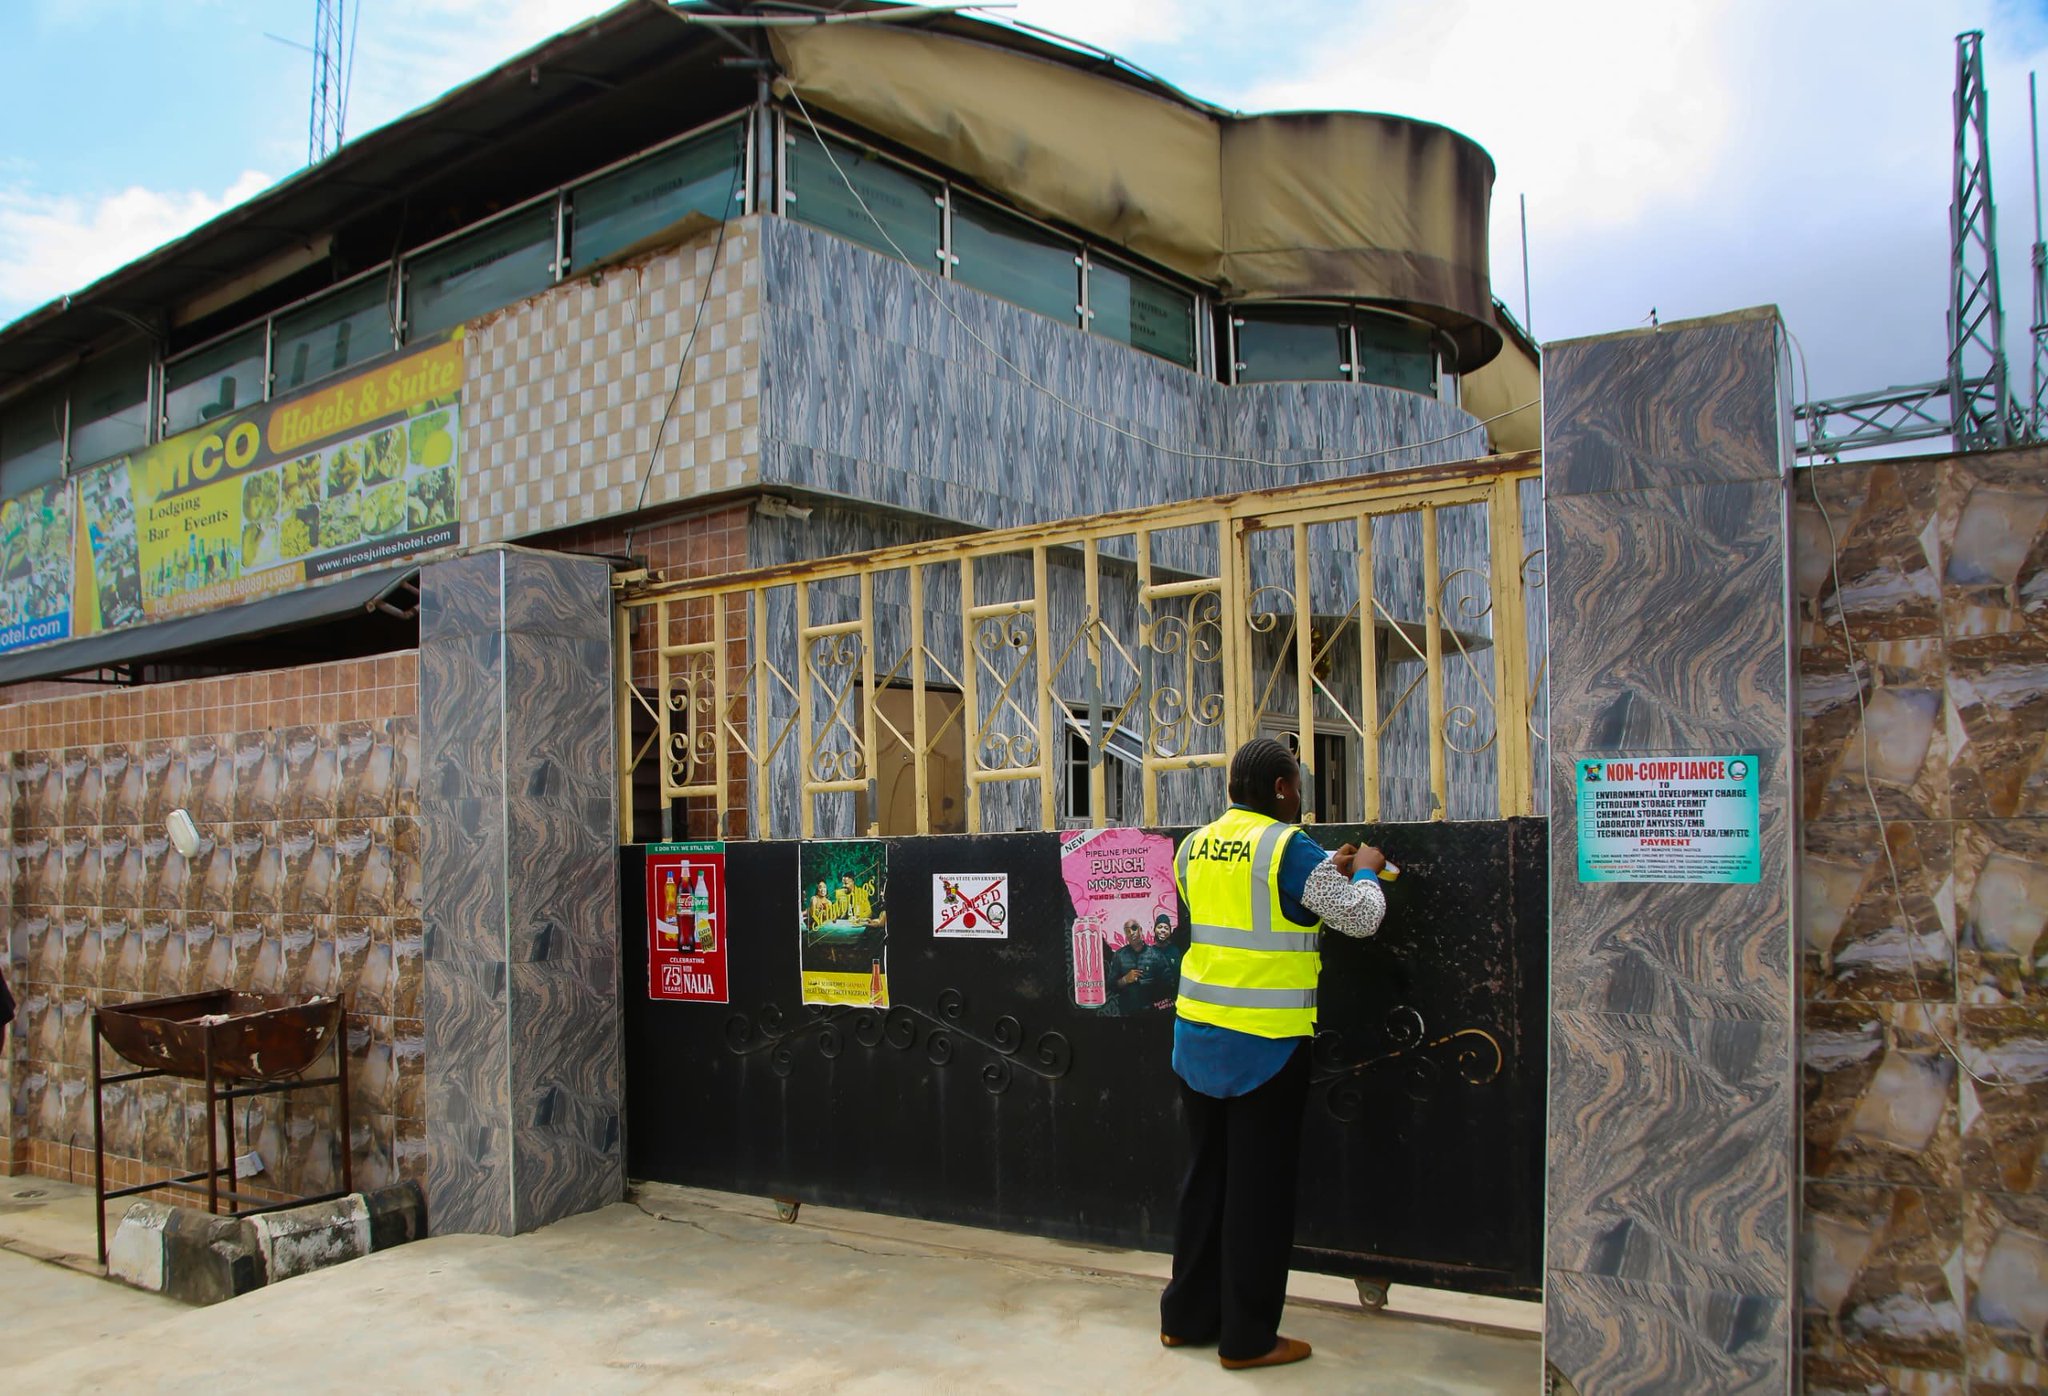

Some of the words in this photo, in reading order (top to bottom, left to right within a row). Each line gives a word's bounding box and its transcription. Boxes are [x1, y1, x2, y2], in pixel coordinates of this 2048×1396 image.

[280, 389, 354, 447] Hotels
[360, 381, 379, 417] &
[386, 359, 455, 408] Suite
[149, 497, 201, 521] Lodging
[148, 528, 170, 543] Bar
[184, 509, 229, 531] Events
[316, 530, 451, 572] www.nicosjuiteshotel.com
[1606, 761, 1725, 782] NON-COMPLIANCE
[1596, 790, 1657, 799] ENVIRONMENTAL
[1658, 789, 1713, 798] DEVELOPMENT
[1715, 789, 1747, 798] CHARGE
[1596, 800, 1639, 809] PETROLEUM
[1642, 800, 1676, 808] STORAGE
[1677, 799, 1706, 808] PERMIT
[1596, 810, 1635, 818] CHEMICAL
[1637, 810, 1671, 818] STORAGE
[1673, 809, 1703, 818] PERMIT
[1596, 820, 1644, 828] LABORATORY
[1597, 830, 1638, 838] TECHNICAL
[1065, 836, 1086, 853] NEW
[1086, 849, 1120, 858] PIPELINE
[1122, 847, 1148, 855] PUNCH
[1189, 838, 1250, 862] LASEPA
[1092, 858, 1145, 875] PUNCH
[1088, 876, 1151, 892] MONSTER
[941, 889, 1001, 921] SEALED
[664, 966, 681, 986] 75
[683, 974, 714, 994] NAIJA
